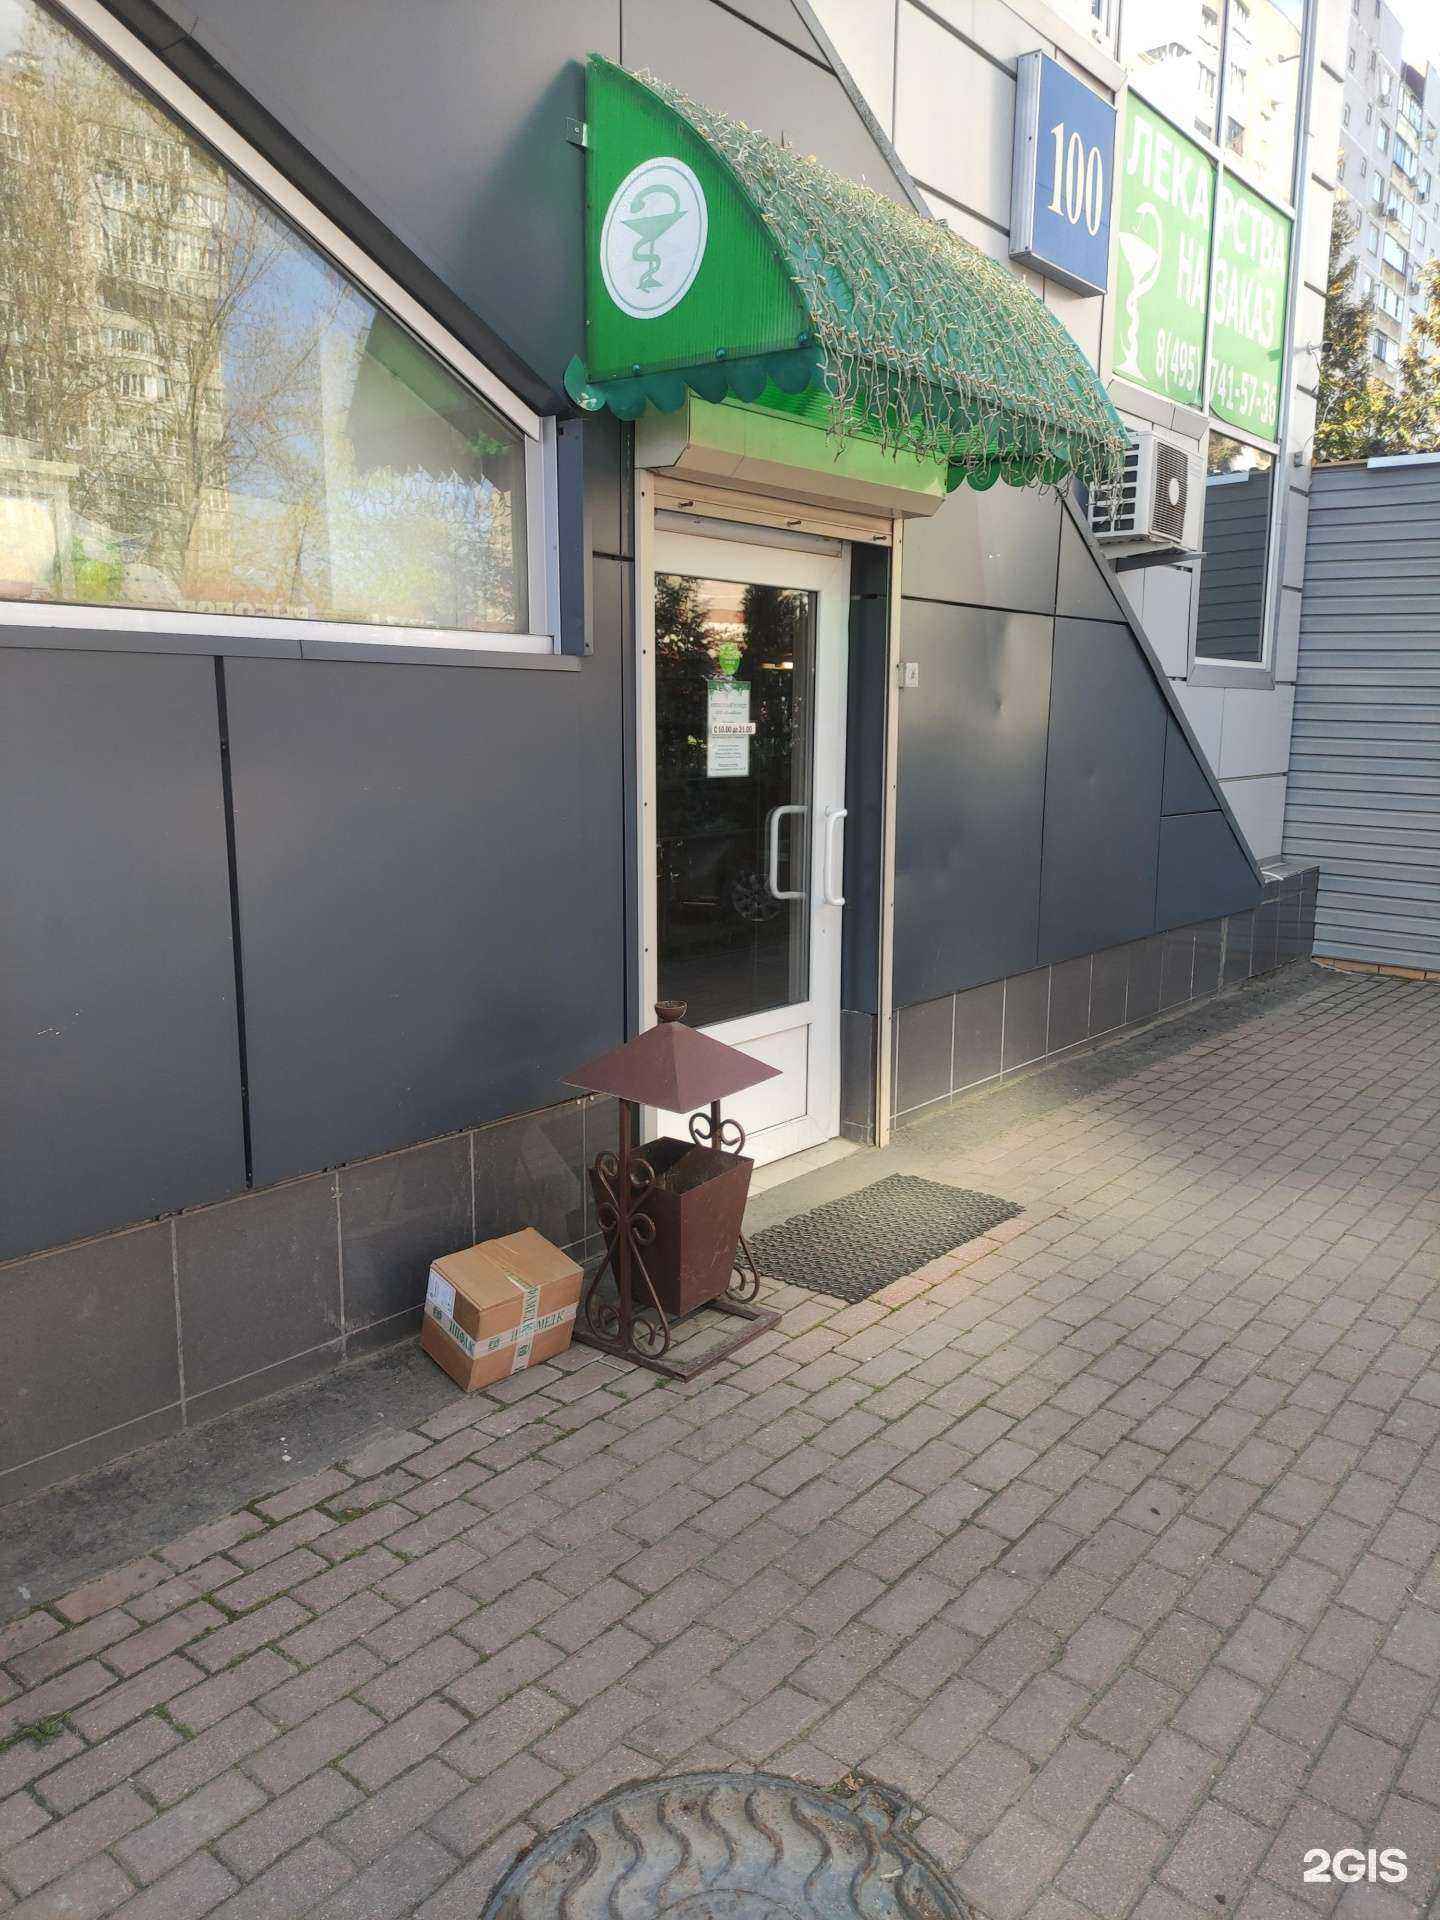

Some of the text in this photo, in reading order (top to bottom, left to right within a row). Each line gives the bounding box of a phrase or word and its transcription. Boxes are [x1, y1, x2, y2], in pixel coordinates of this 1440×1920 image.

[1047, 122, 1103, 237] 100
[1127, 115, 1286, 280] ЛЕКАРСТВА
[1177, 231, 1276, 349] НА ЗАКАЗ
[1155, 327, 1201, 395] 8(495)
